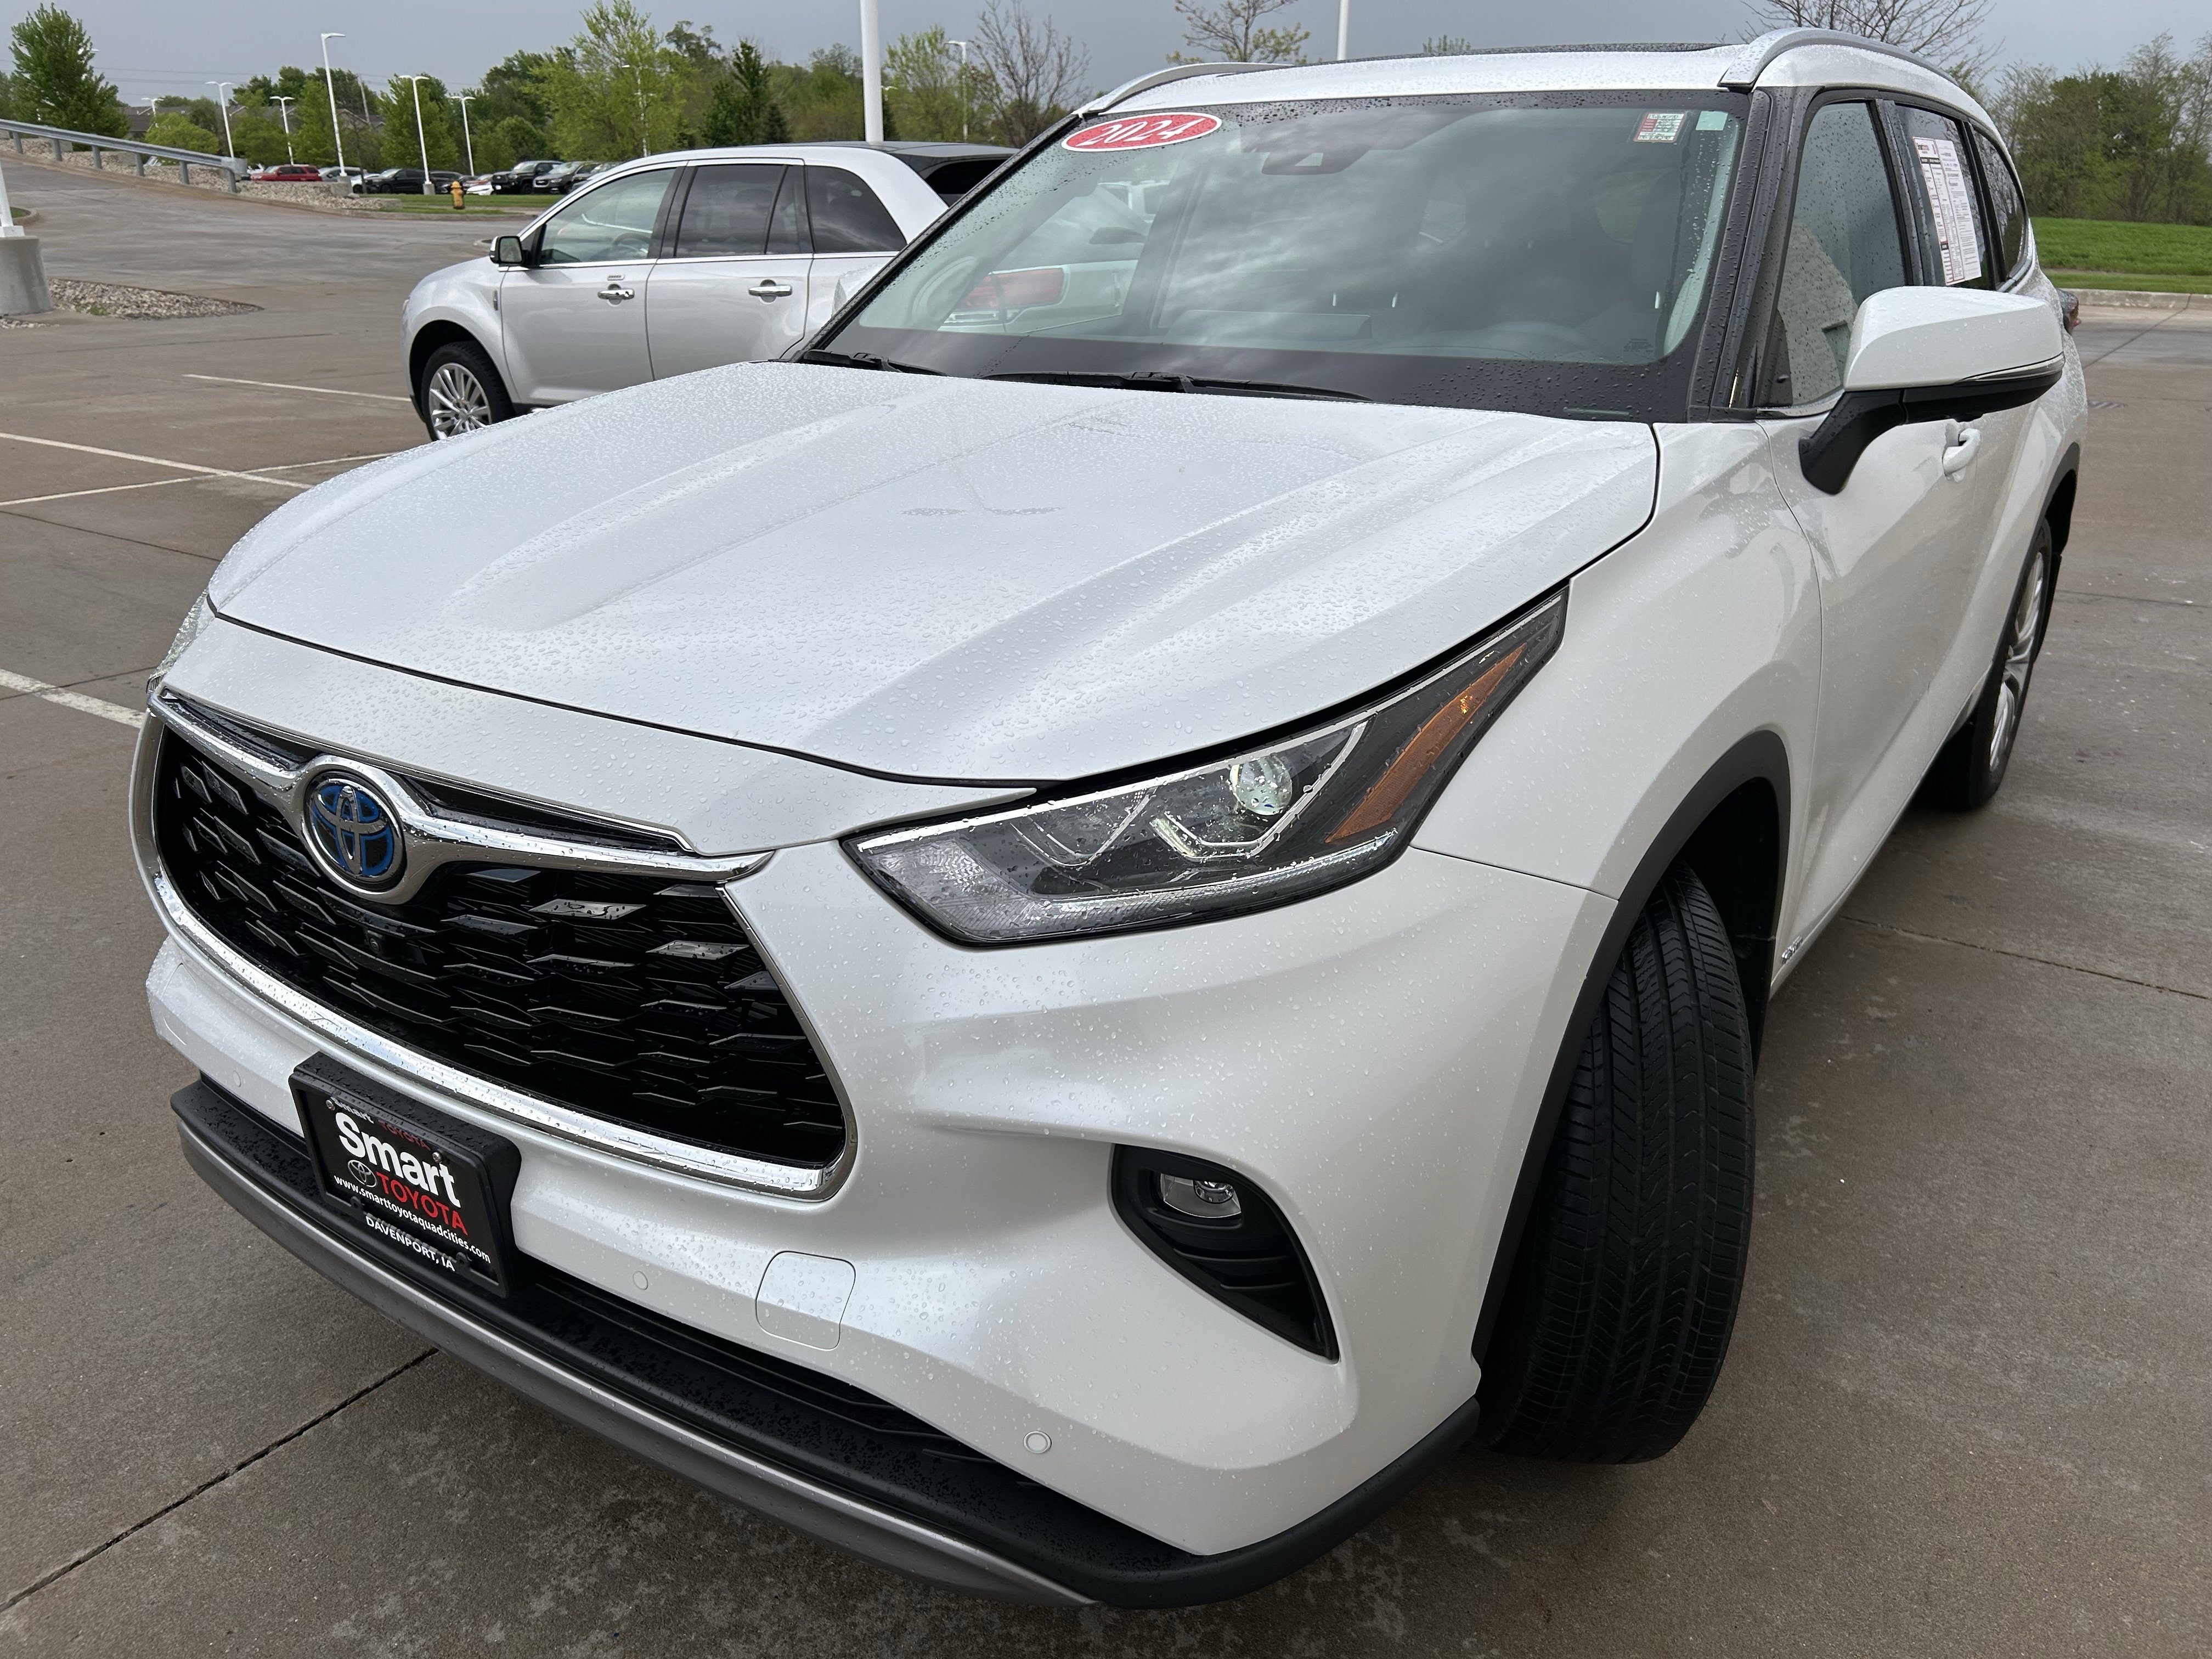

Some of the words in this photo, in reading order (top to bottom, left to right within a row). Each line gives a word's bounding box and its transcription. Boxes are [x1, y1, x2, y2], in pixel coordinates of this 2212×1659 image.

[1075, 117, 1206, 147] 2024
[335, 1111, 461, 1208] Smart
[334, 1175, 492, 1264] www.smarttoyotaquadcities.com
[376, 1171, 469, 1235] TOYOTA
[365, 1216, 439, 1264] DAVENPORT,
[441, 1256, 455, 1272] IA
